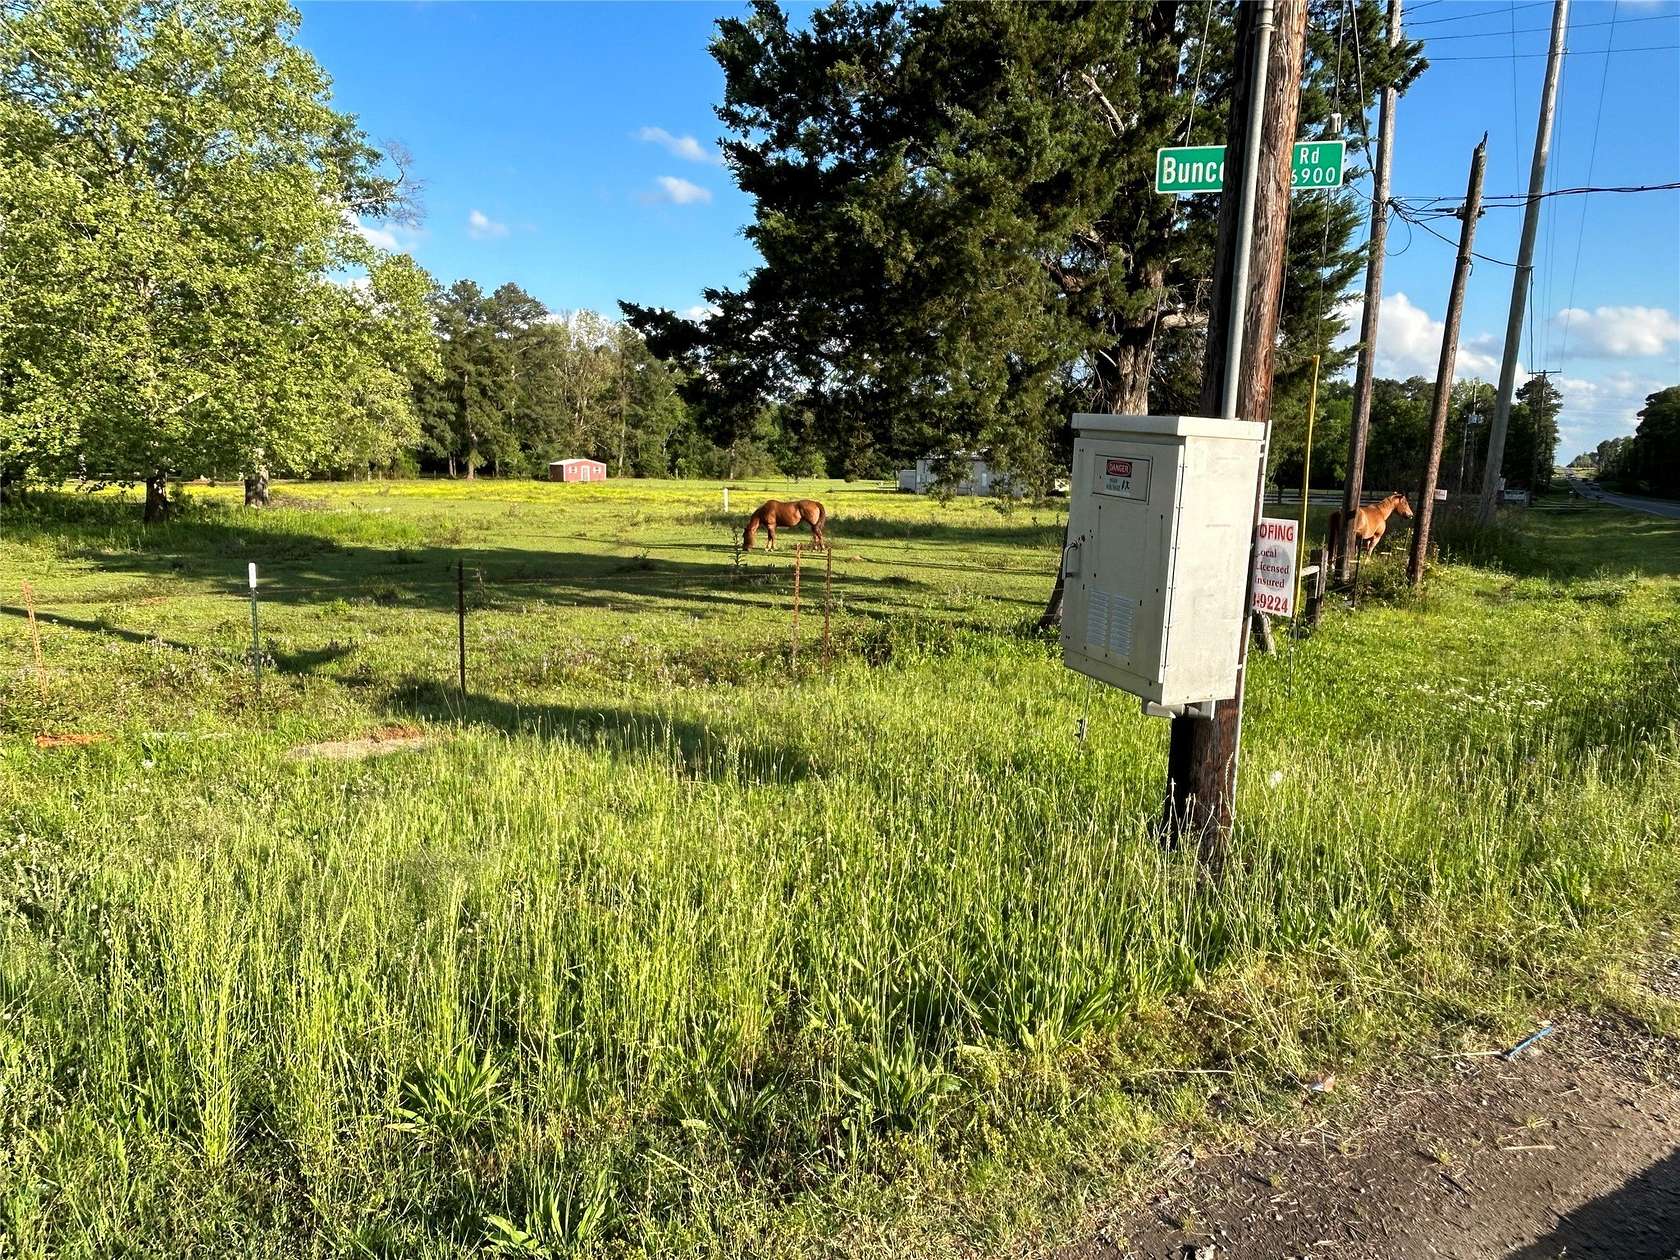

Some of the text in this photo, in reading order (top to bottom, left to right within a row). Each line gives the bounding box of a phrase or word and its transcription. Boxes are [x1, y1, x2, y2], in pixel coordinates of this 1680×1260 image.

[1299, 147, 1320, 165] Rd
[1108, 462, 1130, 473] DANGER
[1258, 523, 1294, 542] OFING
